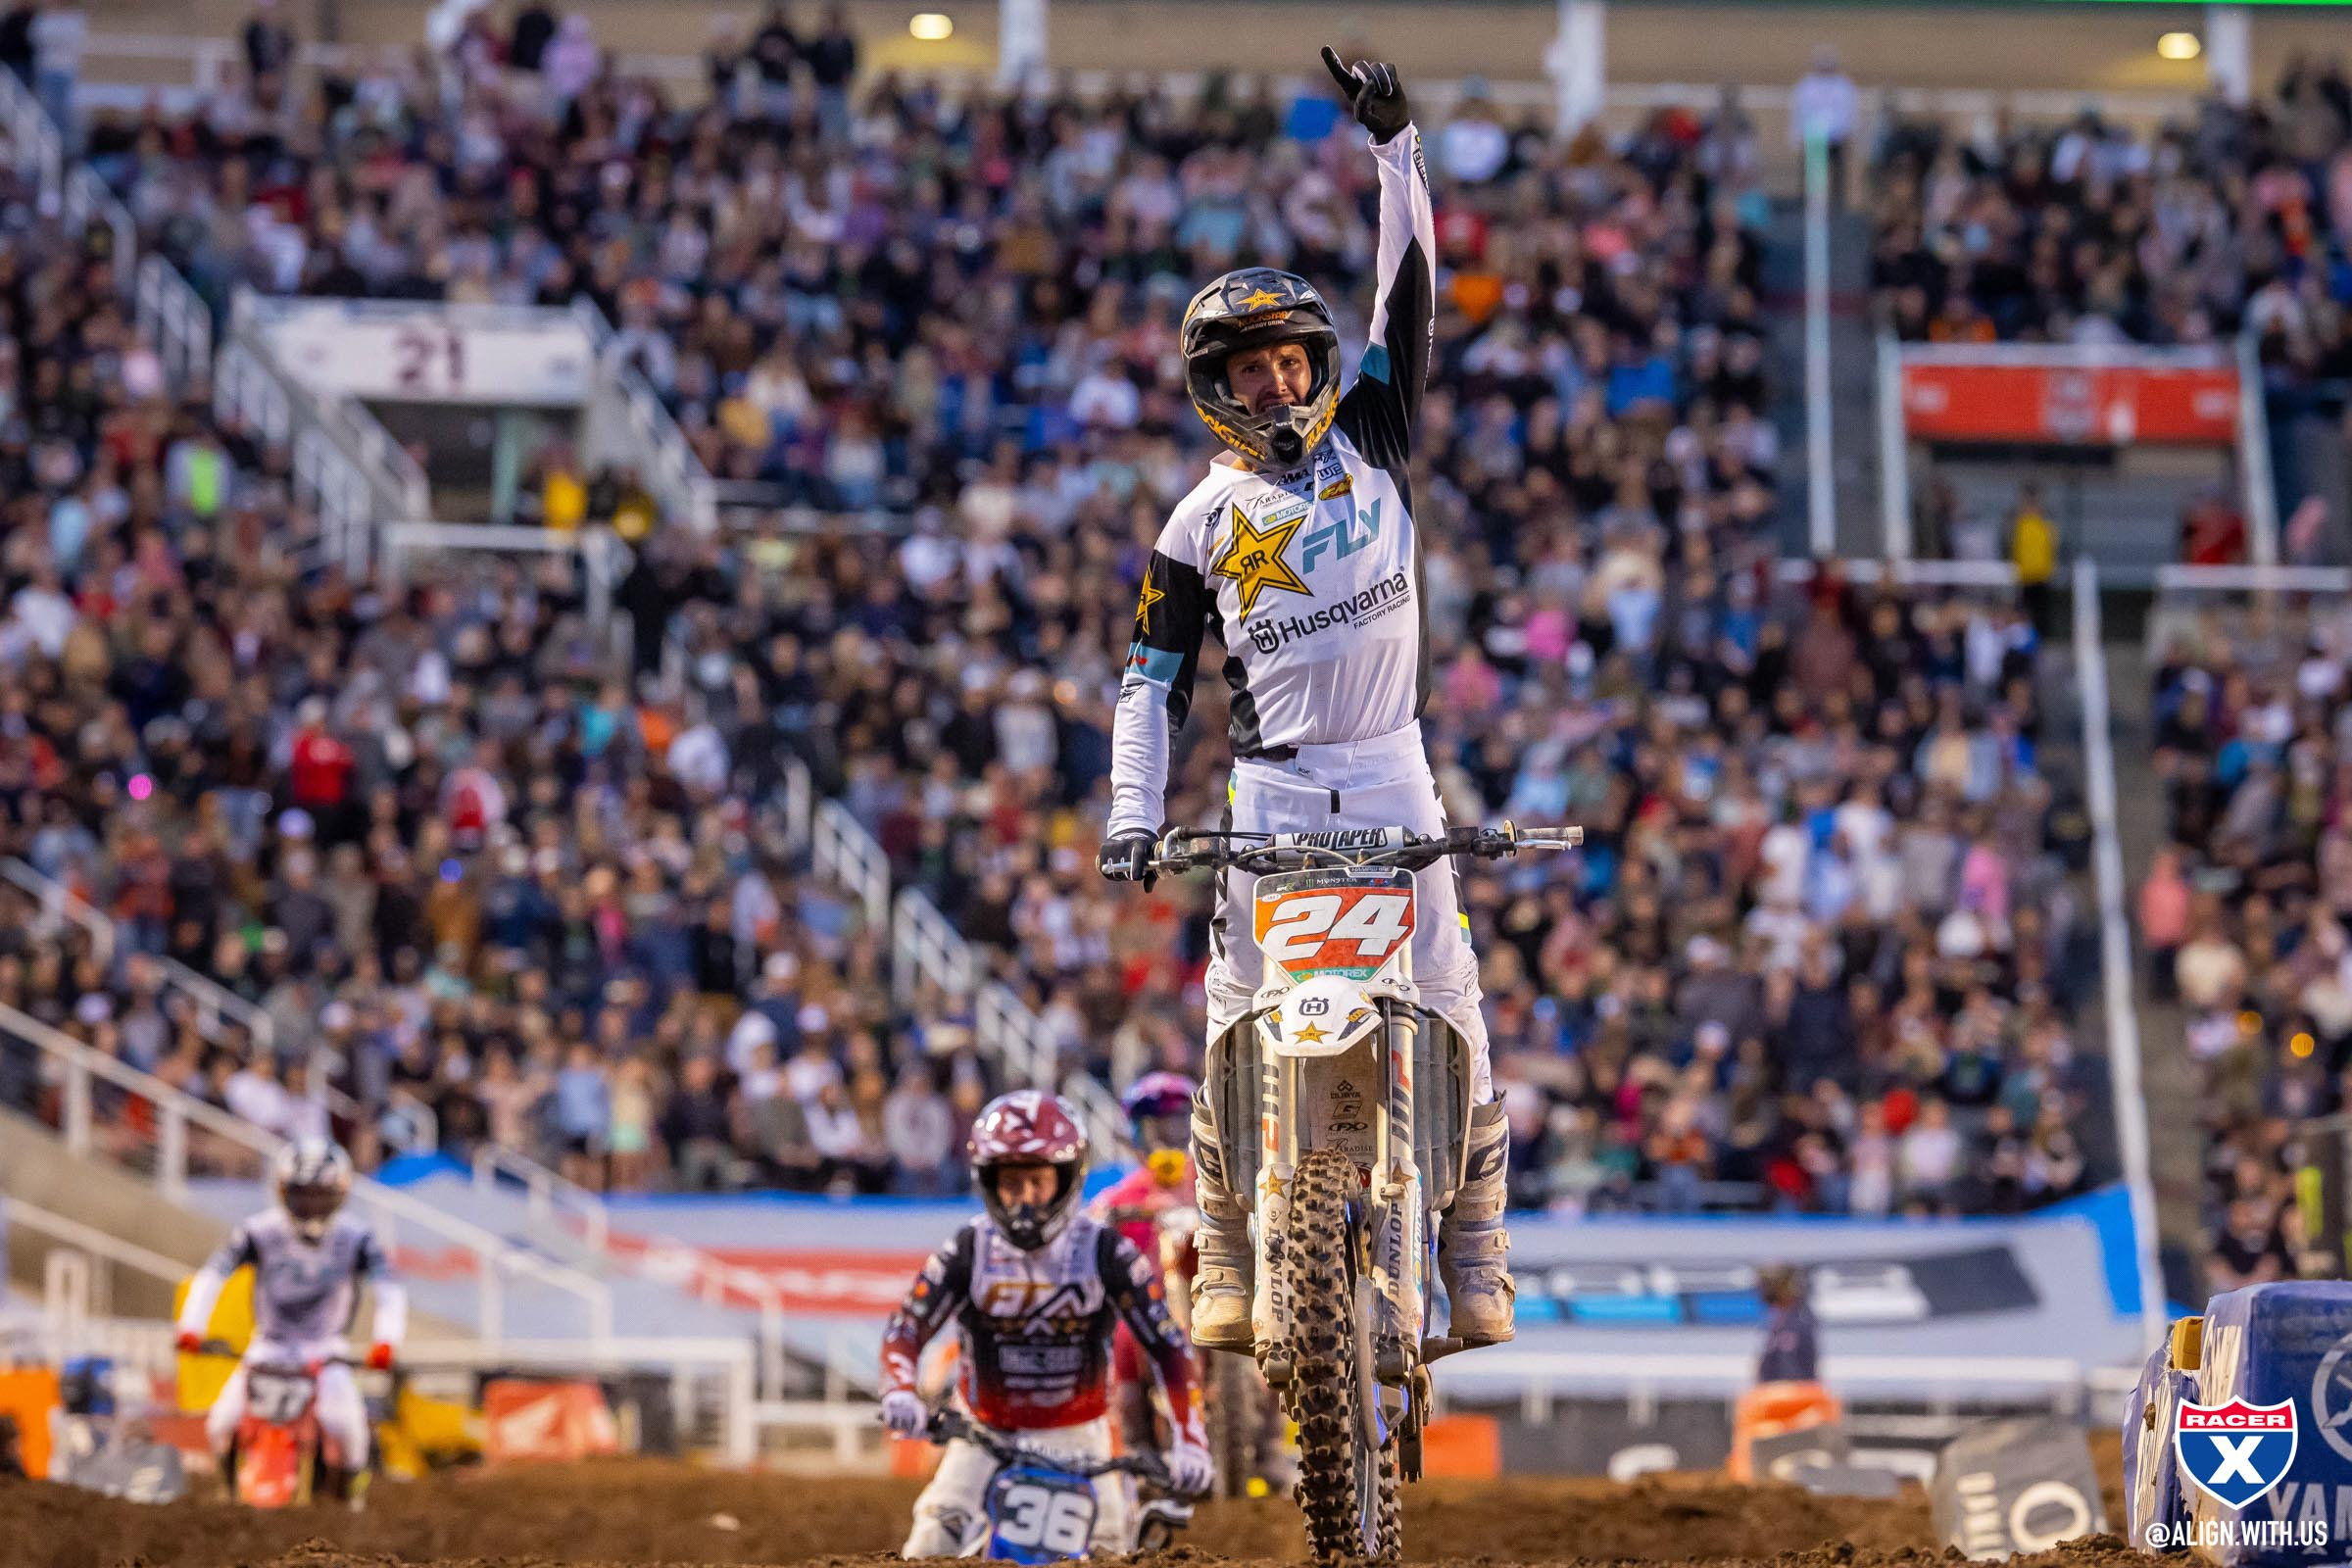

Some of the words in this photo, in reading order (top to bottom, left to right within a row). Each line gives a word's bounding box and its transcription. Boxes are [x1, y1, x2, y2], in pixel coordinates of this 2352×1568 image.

[396, 330, 465, 386] 21
[1302, 497, 1381, 575] FLY
[1278, 571, 1409, 644] Husqvarna
[1353, 608, 1387, 630] FACTORY
[1387, 594, 1411, 612] RACING
[1261, 894, 1411, 962] 24
[1313, 968, 1368, 979] MOTOREX
[1388, 1202, 1403, 1298] DUNLOP
[998, 1486, 1095, 1553] 36
